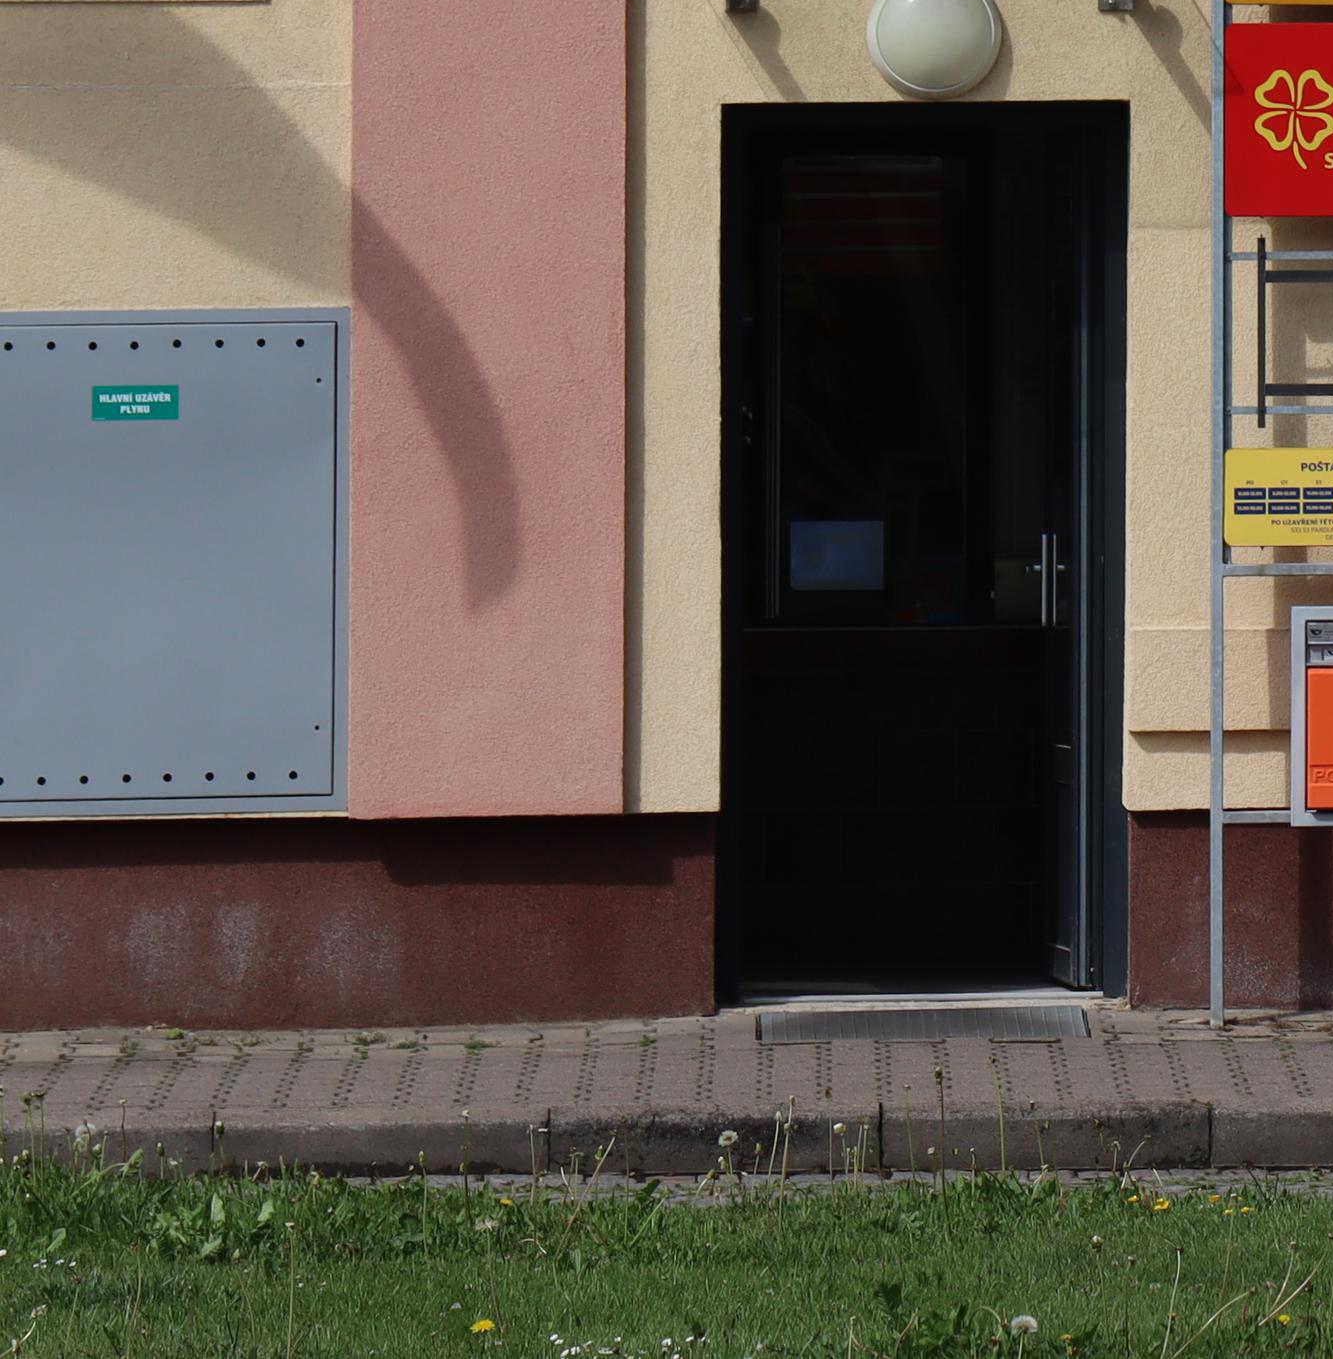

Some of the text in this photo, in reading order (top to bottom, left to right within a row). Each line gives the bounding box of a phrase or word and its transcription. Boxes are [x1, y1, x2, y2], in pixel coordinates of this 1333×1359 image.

[99, 391, 171, 403] HLAVNÍ UZÁVĚR
[120, 405, 150, 414] PLYNU
